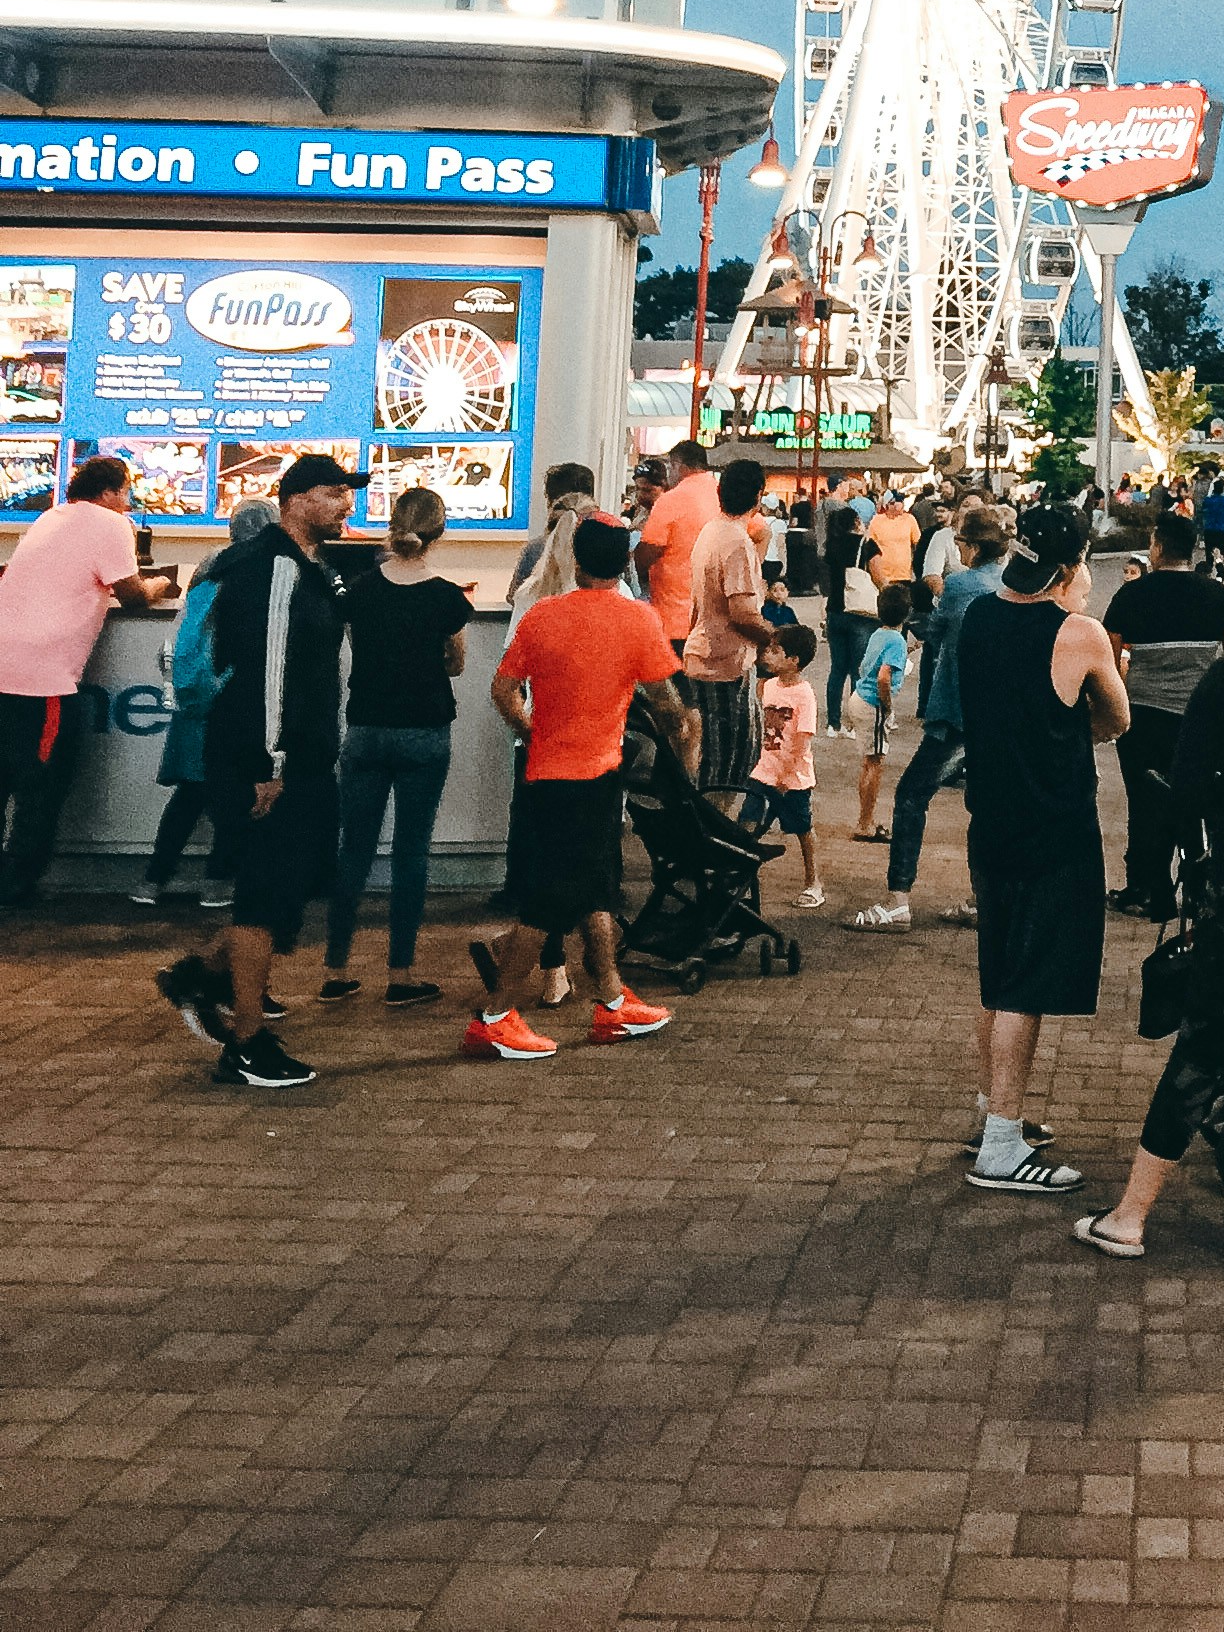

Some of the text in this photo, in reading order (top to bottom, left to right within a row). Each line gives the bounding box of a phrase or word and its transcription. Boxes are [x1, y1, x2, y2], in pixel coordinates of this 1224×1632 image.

[1016, 97, 1196, 161] Speedway
[1137, 105, 1196, 120] NIAGARA
[0, 134, 555, 194] mation Fun Pass
[101, 271, 186, 304] SAVE
[208, 292, 333, 327] FunPass
[775, 437, 842, 450] ADVNURE
